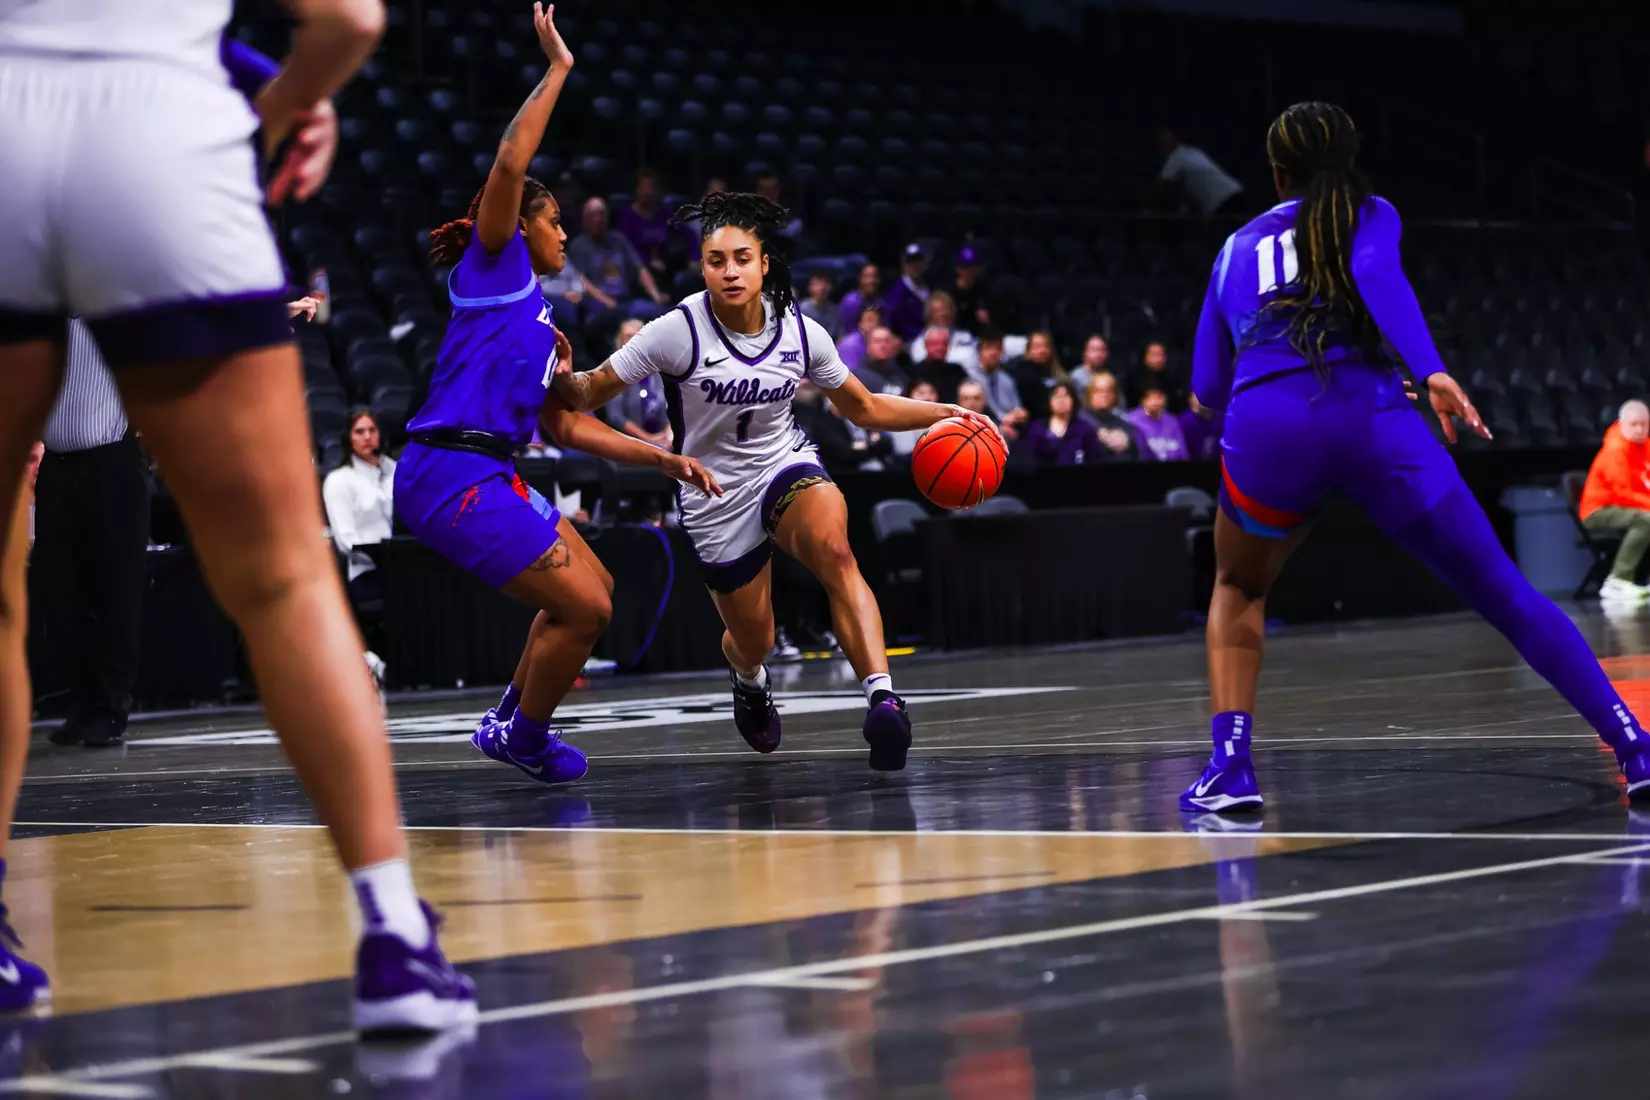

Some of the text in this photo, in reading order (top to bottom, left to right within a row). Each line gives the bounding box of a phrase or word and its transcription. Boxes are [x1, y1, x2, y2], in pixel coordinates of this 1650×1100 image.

[778, 350, 801, 364] XII
[700, 377, 796, 406] Wildcats
[736, 408, 755, 443] 1
